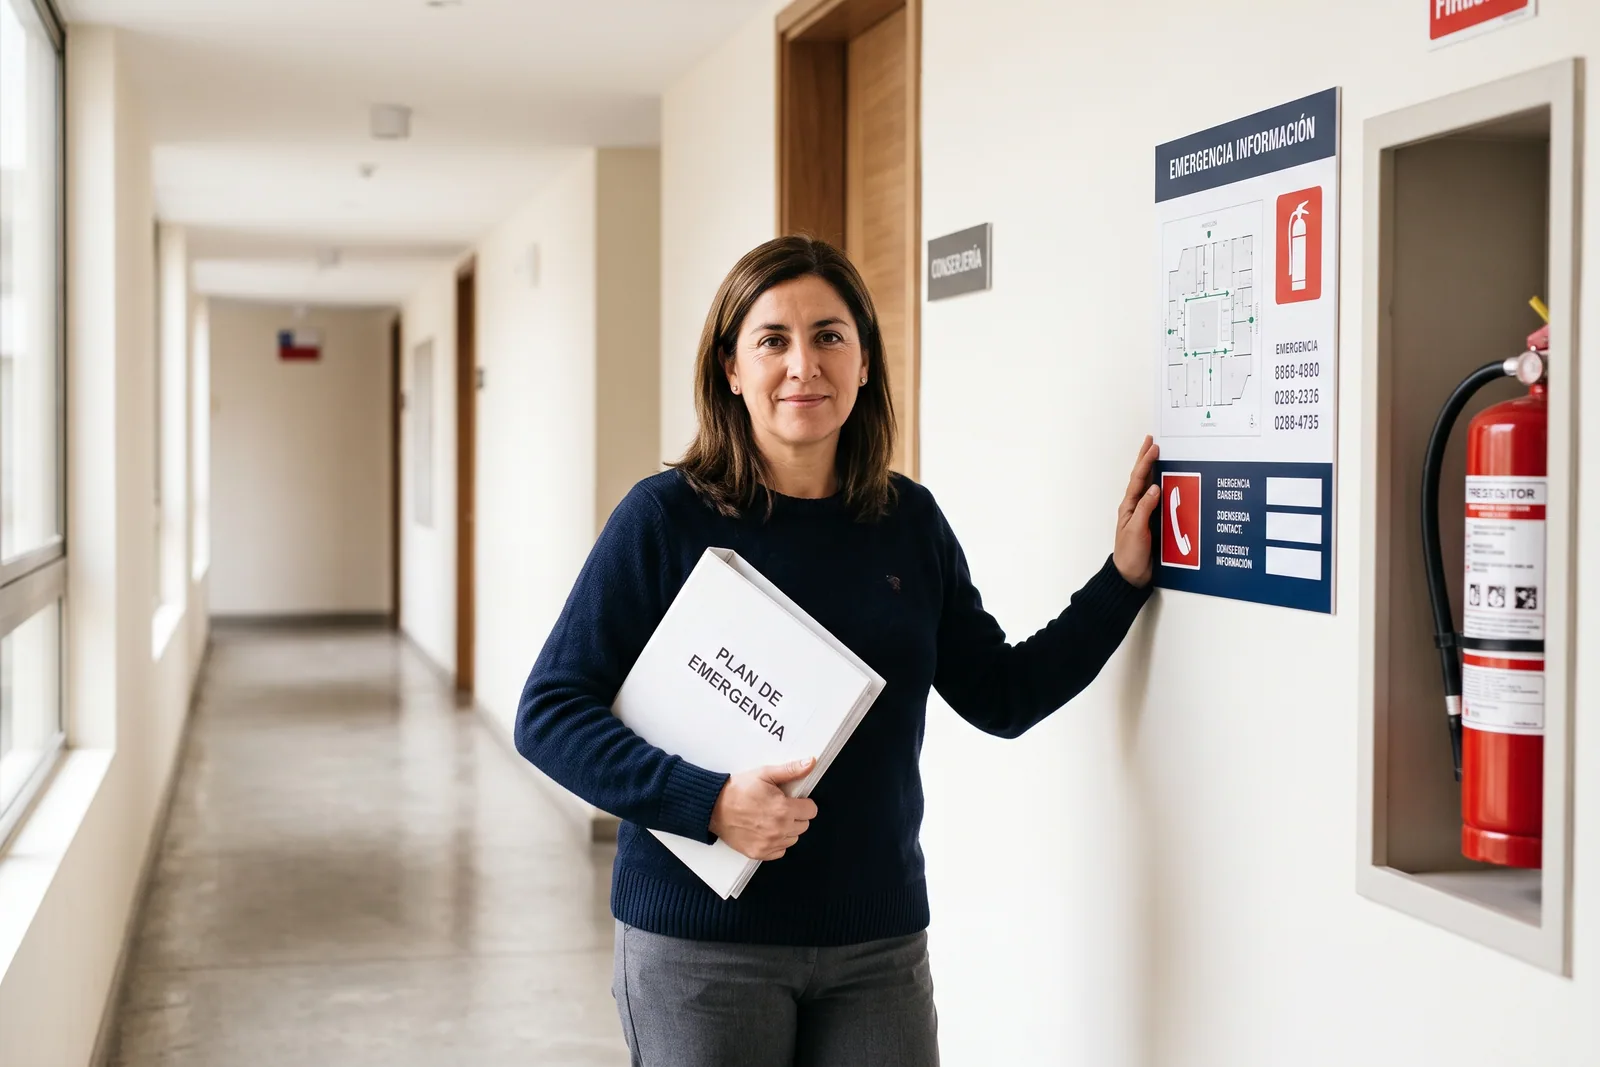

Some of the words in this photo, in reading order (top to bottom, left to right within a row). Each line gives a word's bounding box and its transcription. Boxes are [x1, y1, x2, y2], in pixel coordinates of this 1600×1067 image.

[1169, 142, 1234, 180] EMERGENCIA
[1236, 113, 1316, 161] INFORMACIÓN
[1275, 340, 1318, 355] EMERGENCIA
[687, 653, 786, 742] EMERGENCIA
[715, 646, 759, 688] PLAN
[757, 681, 784, 708] DE
